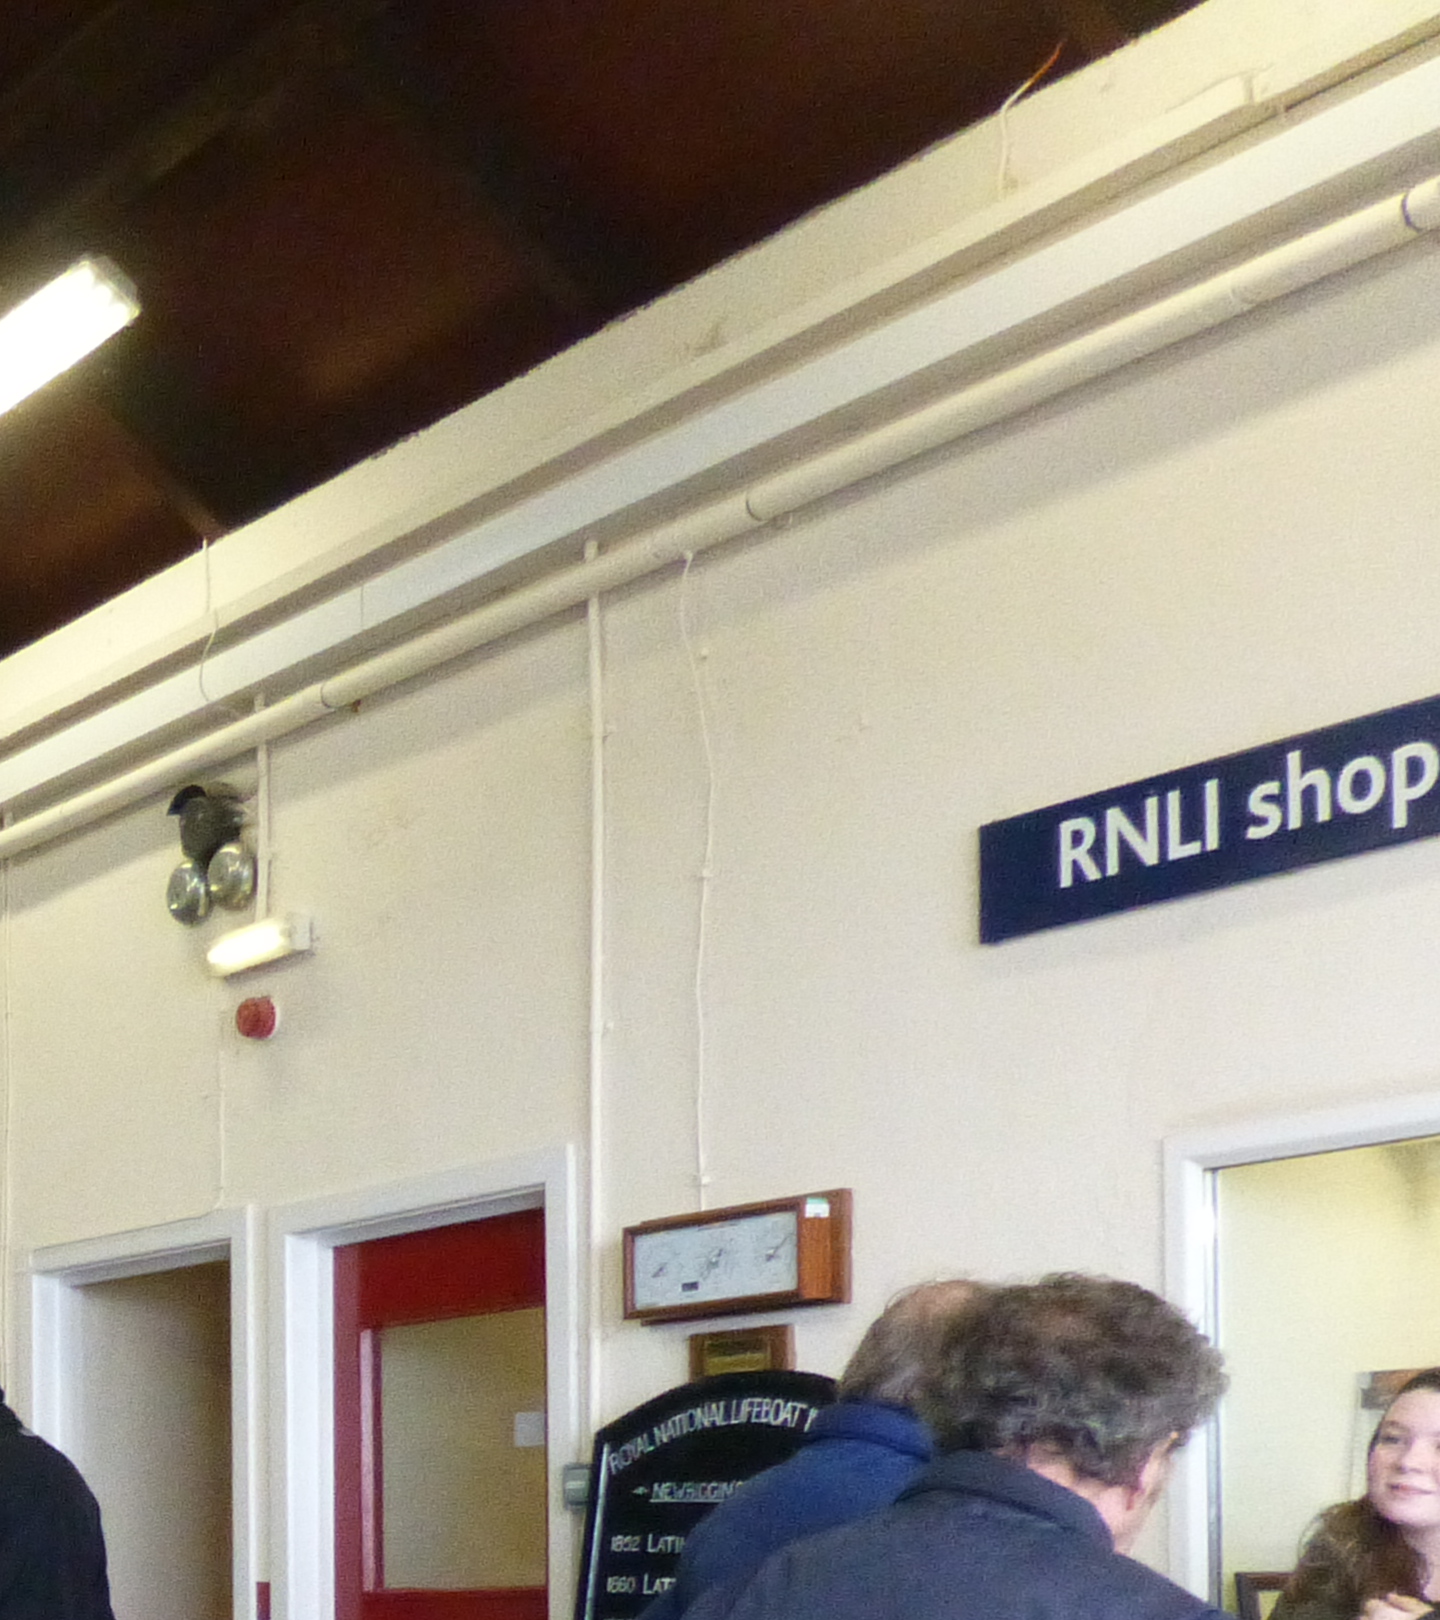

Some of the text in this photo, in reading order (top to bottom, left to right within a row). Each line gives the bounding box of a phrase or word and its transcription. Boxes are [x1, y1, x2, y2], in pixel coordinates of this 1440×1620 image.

[1059, 740, 1440, 888] RNLI shop
[609, 1432, 654, 1474] ROYAL
[653, 1400, 728, 1445] NATIONAL
[729, 1398, 808, 1427] LIFEBOAT
